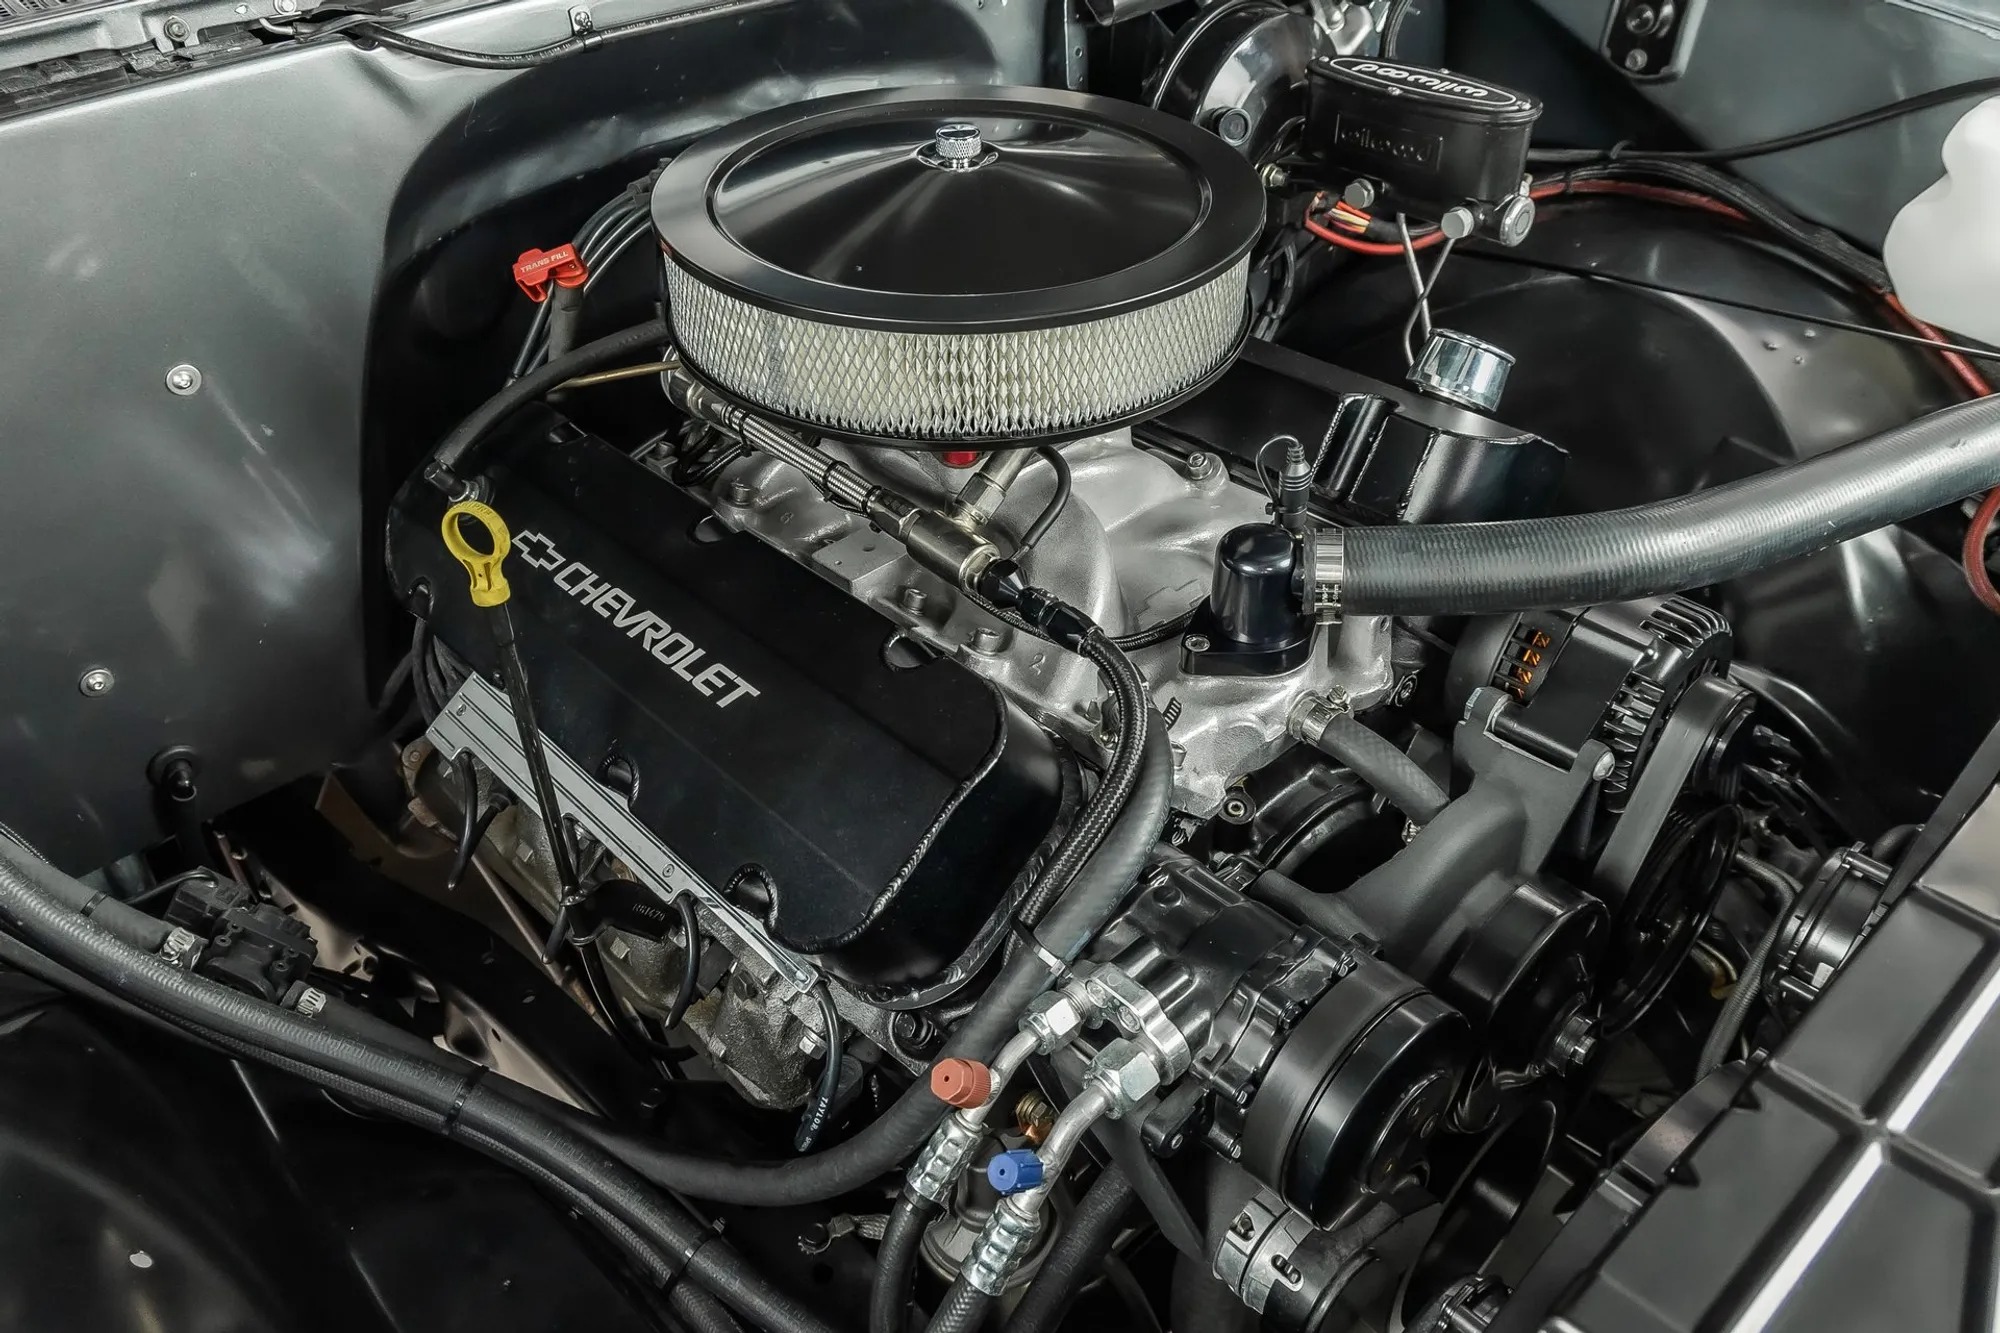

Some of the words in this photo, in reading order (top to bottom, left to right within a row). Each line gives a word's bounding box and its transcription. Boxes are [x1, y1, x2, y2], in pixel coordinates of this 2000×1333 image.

[1351, 63, 1489, 98] wilwood
[520, 257, 550, 273] TRANS
[550, 250, 569, 263] FILL
[553, 561, 761, 708] CHEVROLET
[810, 1096, 829, 1131] TAYLOR
